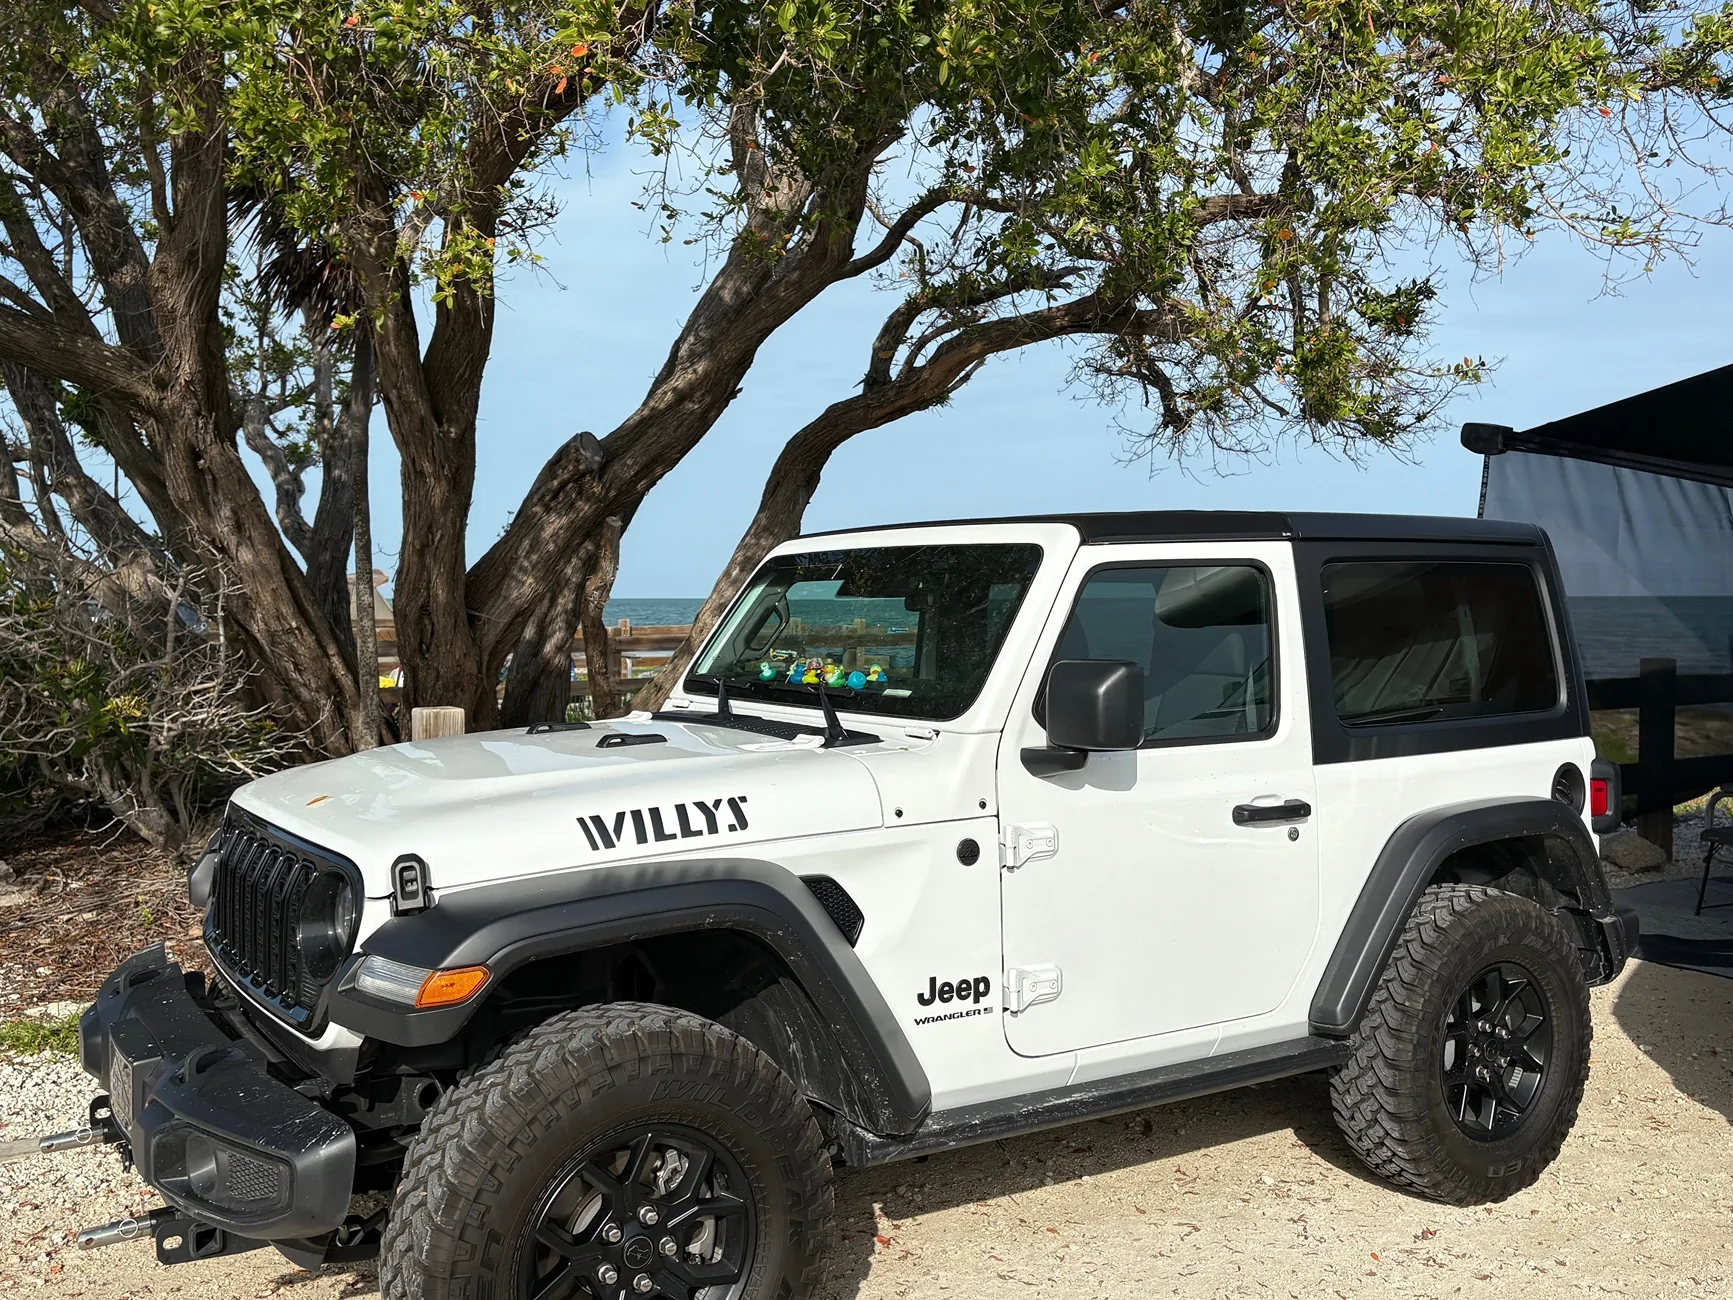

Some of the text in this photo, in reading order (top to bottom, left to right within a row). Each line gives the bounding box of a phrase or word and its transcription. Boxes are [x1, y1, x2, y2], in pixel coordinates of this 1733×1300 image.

[576, 796, 749, 851] WILLYS
[917, 976, 990, 1006] Jeep
[914, 1009, 981, 1026] WRANGLER
